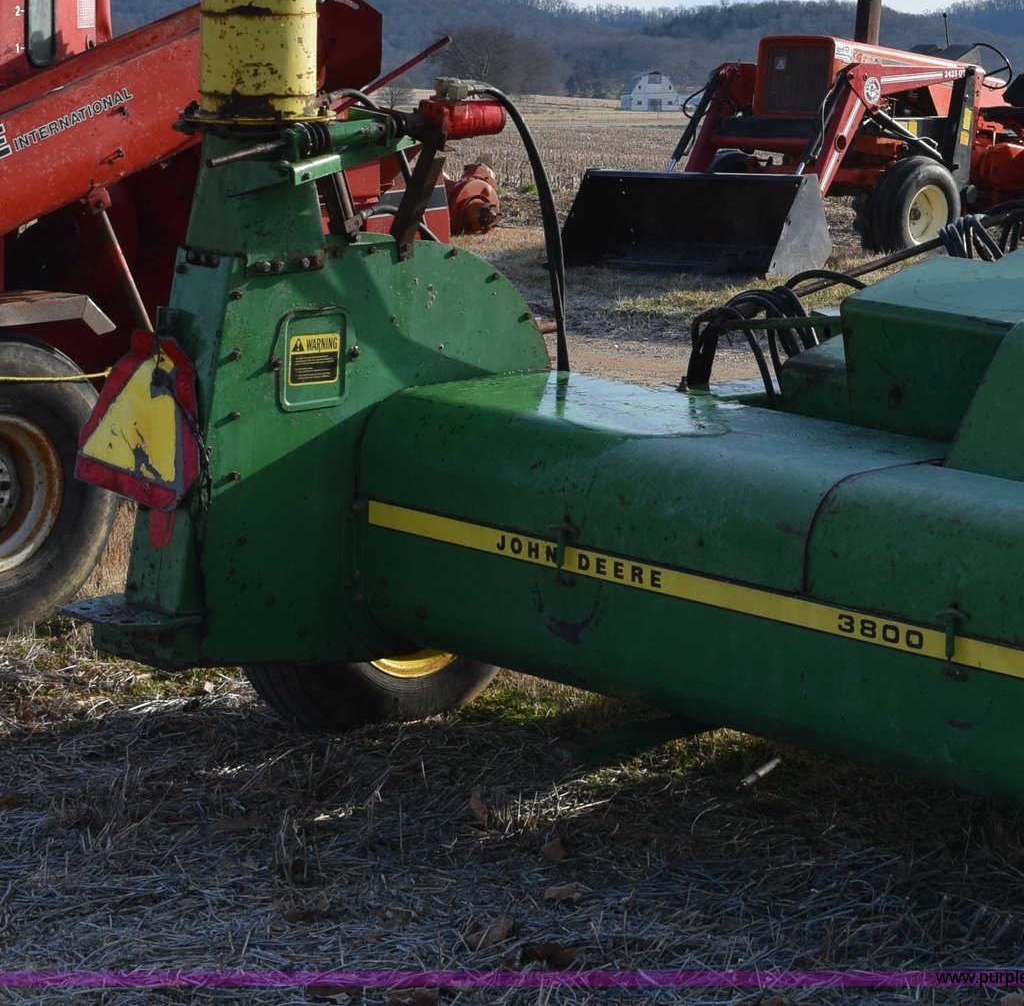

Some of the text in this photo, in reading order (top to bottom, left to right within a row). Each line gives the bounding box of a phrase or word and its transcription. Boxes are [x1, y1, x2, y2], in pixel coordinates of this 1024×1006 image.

[15, 5, 20, 17] 2
[944, 69, 958, 78] 2425
[13, 87, 134, 152] INTERNATIONAL
[306, 336, 338, 351] WARNING
[496, 535, 662, 589] JOHN DEERE
[837, 613, 924, 650] 3800
